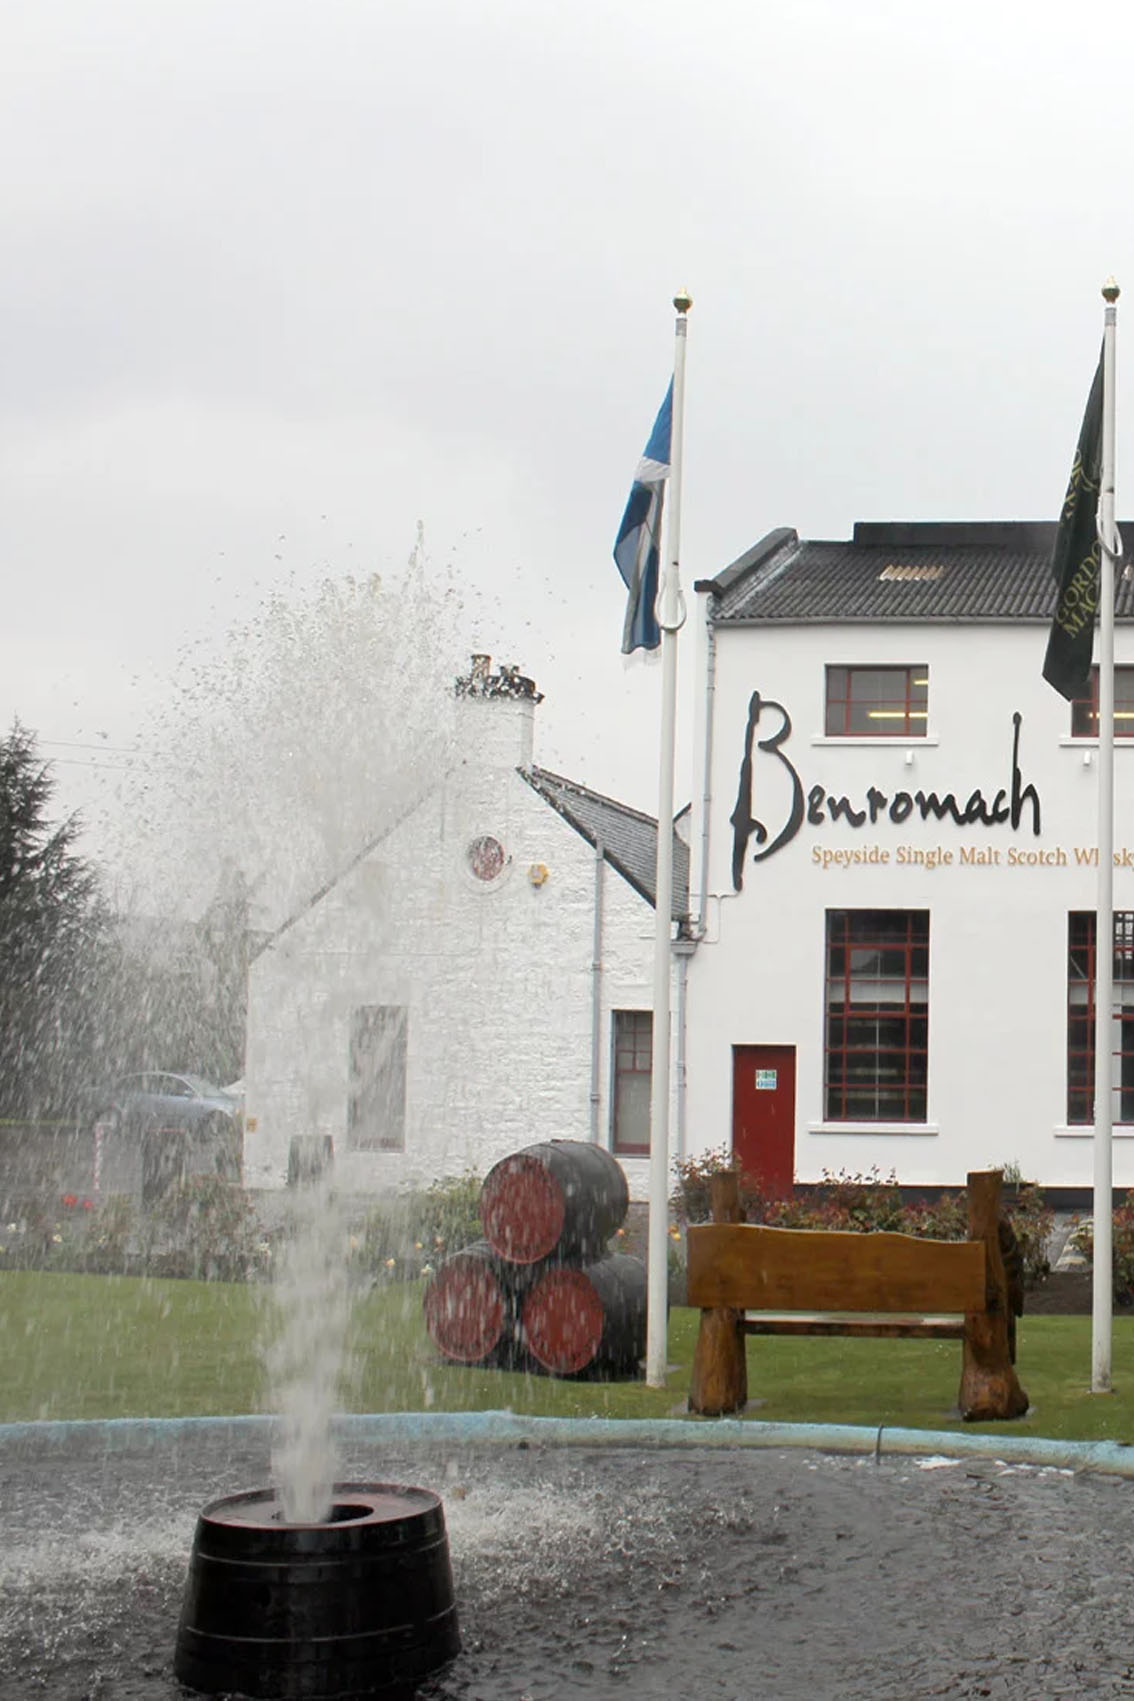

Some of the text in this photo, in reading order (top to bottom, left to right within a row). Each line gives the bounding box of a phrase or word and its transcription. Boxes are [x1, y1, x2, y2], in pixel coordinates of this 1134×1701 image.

[730, 690, 1041, 892] Benromach
[811, 846, 890, 868] Speyside
[895, 846, 953, 869] Single
[959, 846, 1000, 865] Malt
[1007, 846, 1067, 866] Scotch
